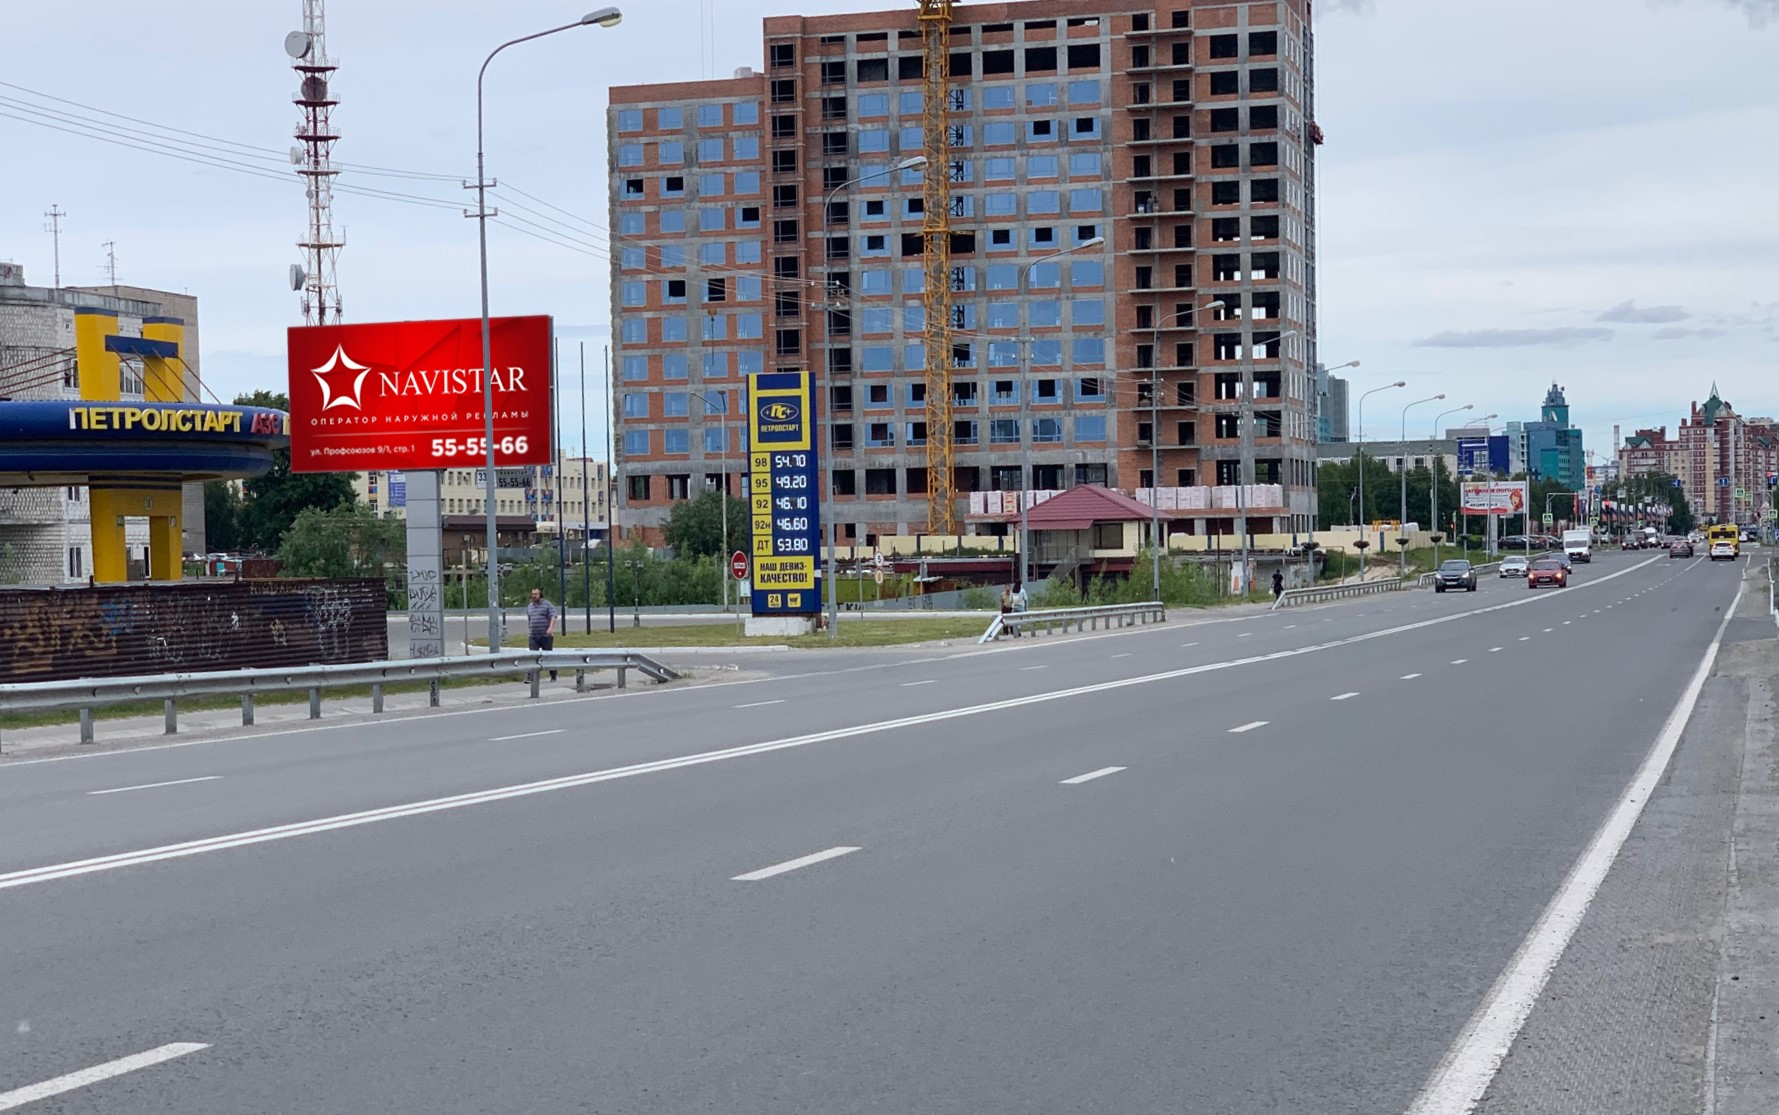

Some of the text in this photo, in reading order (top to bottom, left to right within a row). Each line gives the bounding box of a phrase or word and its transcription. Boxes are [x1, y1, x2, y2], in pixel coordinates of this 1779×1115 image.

[378, 366, 528, 397] NAVISTAR
[69, 407, 243, 432] ПЕТРОЛСТАРТ
[311, 411, 529, 426] ОПЕРАТОР НАРУЖНОЙ РЕЛАМЫ
[760, 424, 799, 433] ПЕТРОЛСТАРТ
[310, 448, 322, 457] ул.
[323, 447, 376, 456] Профсоюзов
[377, 445, 392, 454] 9/1,
[755, 454, 806, 467] 98 54.70
[498, 478, 531, 488] 55-55-66
[755, 475, 807, 488] 95 49.20
[756, 497, 807, 509] 92 46.10
[777, 518, 808, 530] 46.60
[757, 538, 808, 551] ДТ 53.80
[760, 563, 777, 572] НАШ
[760, 572, 808, 583] КАЧЕСТВО!
[769, 595, 779, 603] 24
